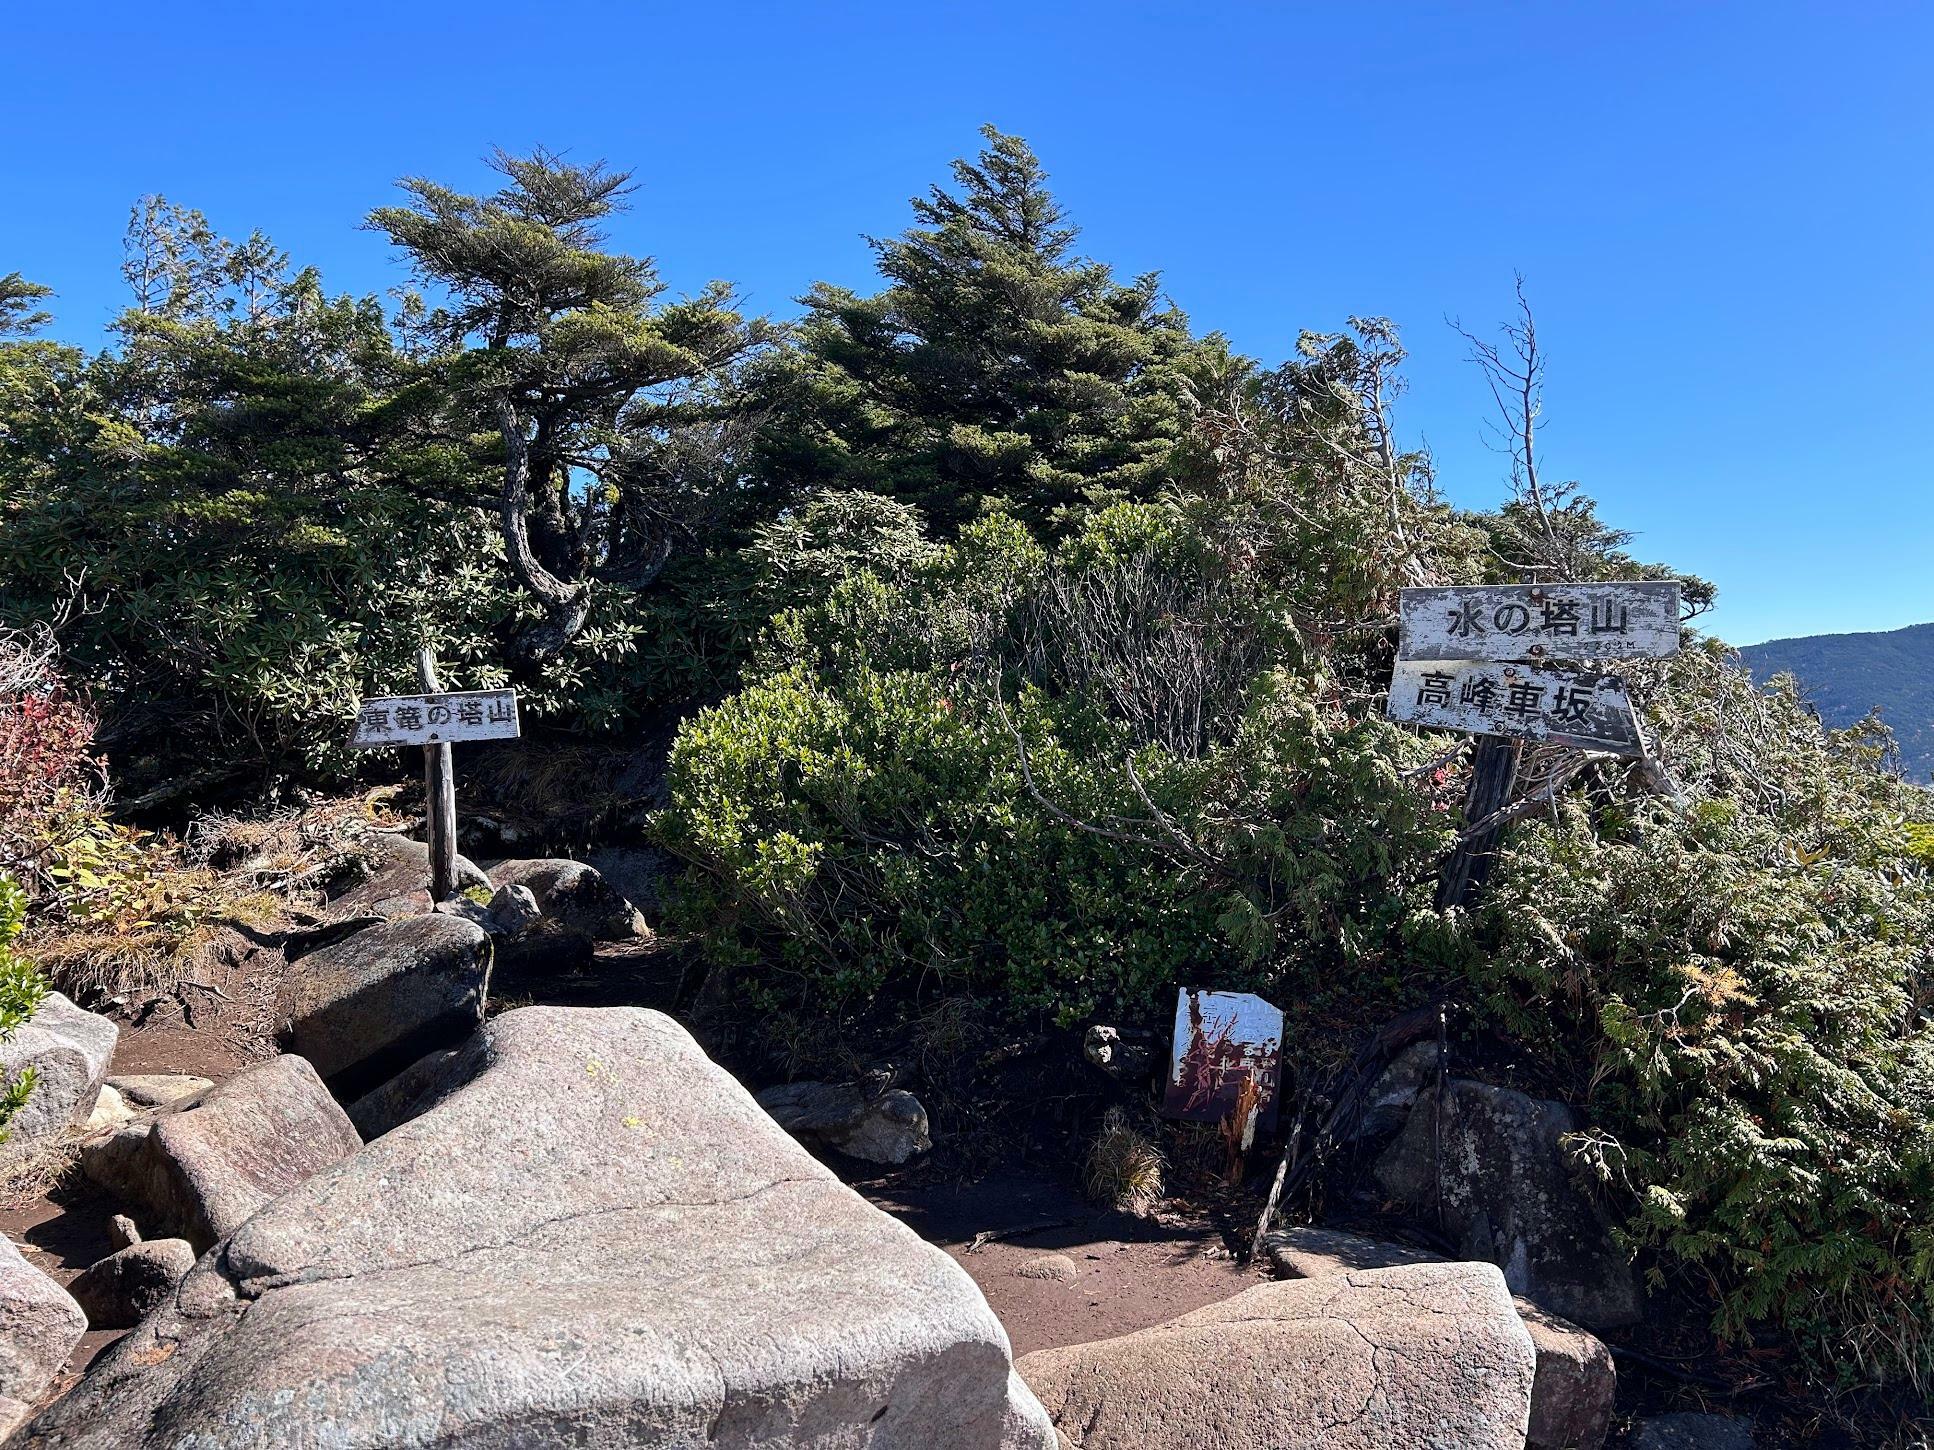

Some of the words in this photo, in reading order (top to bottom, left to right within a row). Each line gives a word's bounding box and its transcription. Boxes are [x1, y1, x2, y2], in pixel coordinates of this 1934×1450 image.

[1447, 598, 1628, 638] 水の塔山
[1416, 670, 1595, 727] 高峰車坂
